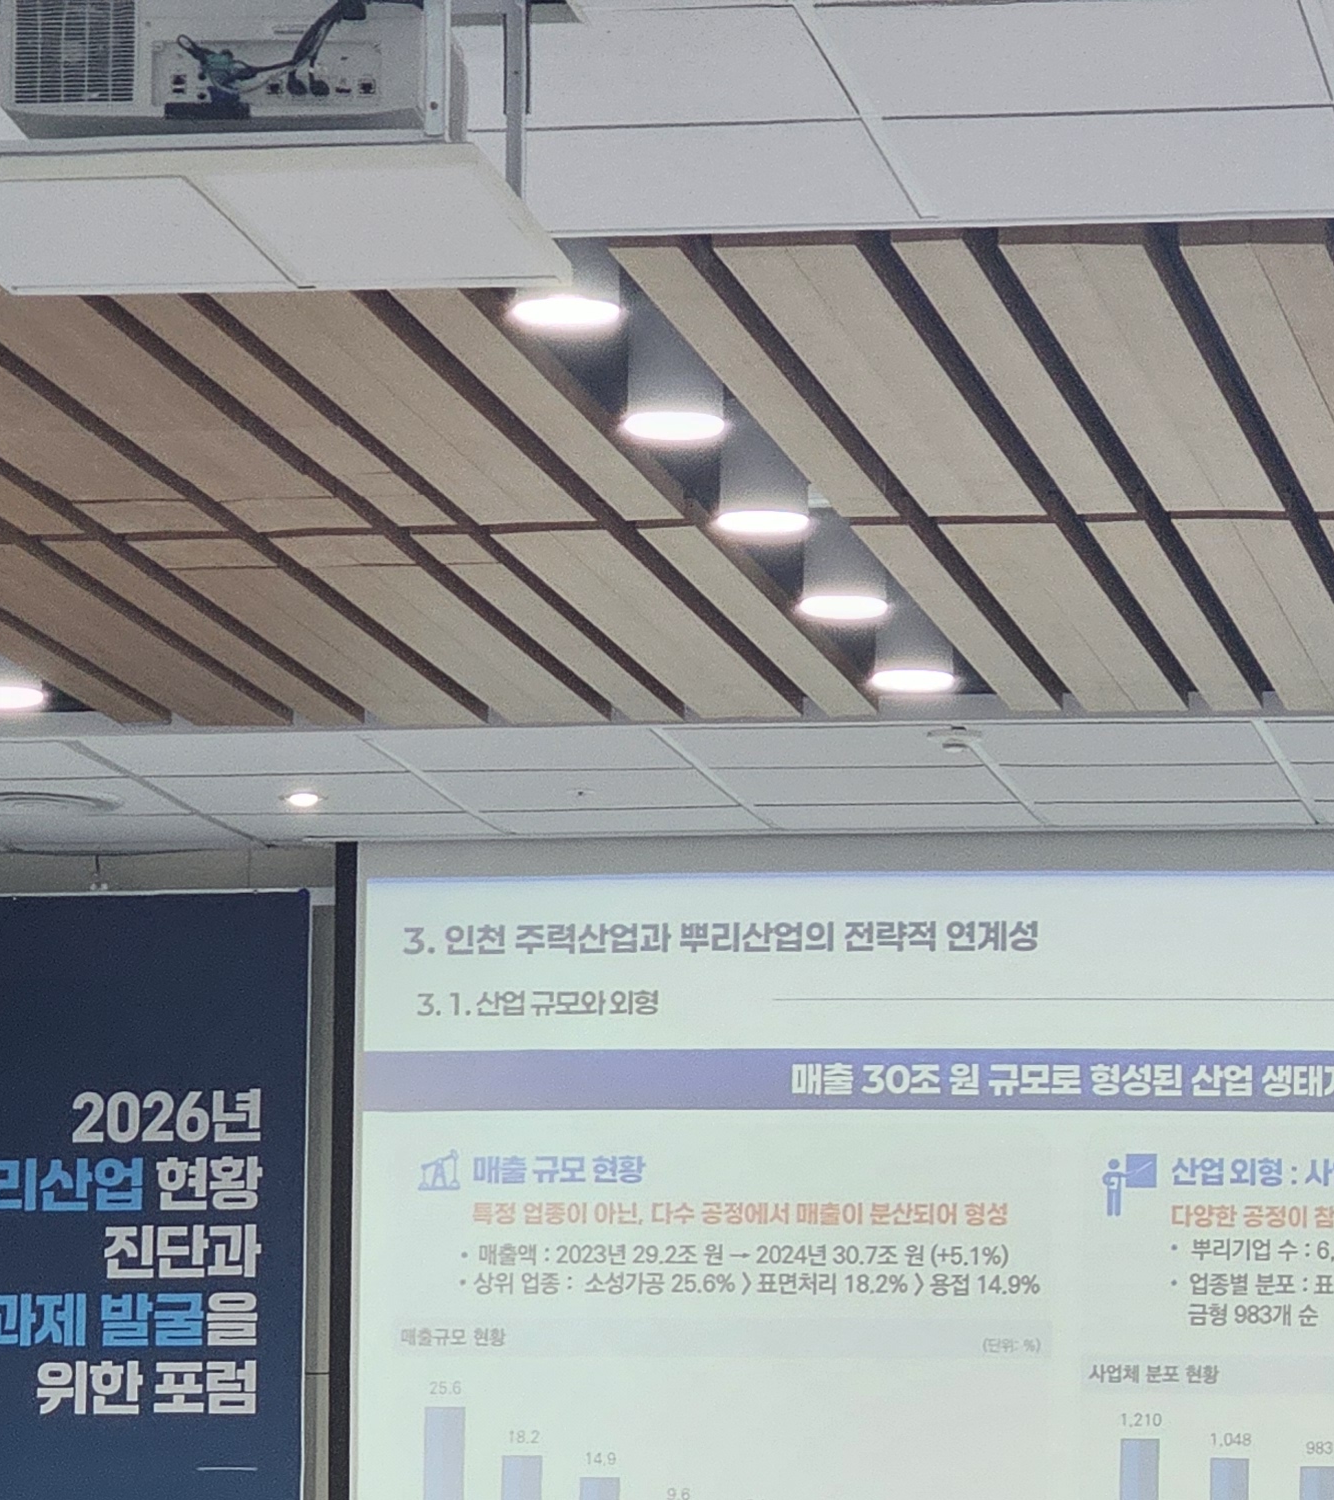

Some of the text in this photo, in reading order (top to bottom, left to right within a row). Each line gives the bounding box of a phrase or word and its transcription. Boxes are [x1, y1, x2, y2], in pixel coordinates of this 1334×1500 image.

[403, 921, 1038, 955] 3. 인천 주력산업과 뿌리산업의 전략적 연계성
[476, 991, 525, 1016] 산업
[531, 990, 606, 1016] 규모와
[609, 990, 658, 1015] 외형
[792, 1063, 853, 1095] 매출
[862, 1064, 940, 1094] 30조
[949, 1064, 979, 1095] 원
[988, 1064, 1081, 1096] 규모로
[1090, 1064, 1182, 1096] 형성된
[1192, 1065, 1252, 1096] 산업
[72, 1088, 261, 1143] 2026년
[473, 1155, 646, 1184] 매출 규모 현황
[1172, 1158, 1224, 1186] 산업
[1230, 1158, 1282, 1187] 외형
[156, 1156, 263, 1210] 현황
[472, 1202, 1007, 1226] 특정 업종이 아닌, 다수 공정에서 매출이 분산되어 형성
[1172, 1205, 1237, 1228] 다양한
[1243, 1205, 1307, 1228] 공정이
[104, 1224, 261, 1279] 진단과
[479, 1243, 536, 1266] 매출액
[556, 1244, 626, 1266] 2023년
[633, 1245, 698, 1264] 29.2조
[704, 1244, 723, 1266] 원
[756, 1244, 826, 1266] 2024년
[833, 1245, 898, 1265] 30.7조
[905, 1244, 924, 1267] 원
[931, 1244, 1009, 1268] (+5.1%)
[1191, 1238, 1270, 1261] 뿌리기업
[1278, 1239, 1298, 1261] 수
[474, 1272, 513, 1295] 상위
[521, 1272, 560, 1295] 업종
[585, 1272, 665, 1295] 소성가공
[671, 1273, 735, 1293] 25.6%
[757, 1273, 836, 1295] 표면처리
[845, 1274, 908, 1294] 18.2%
[930, 1273, 969, 1296] 용접
[978, 1275, 1040, 1295] 14.9%
[1190, 1273, 1248, 1296] 업종별
[1255, 1274, 1295, 1296] 분포
[101, 1292, 258, 1346] 발굴을
[1188, 1303, 1318, 1327] 금형 983개 순
[401, 1328, 506, 1347] 매출규모 현황
[1089, 1364, 1219, 1384] 사업체 분포 현황
[37, 1360, 256, 1414] 위한 포럼
[430, 1380, 461, 1395] 25.6
[1121, 1412, 1162, 1427] 1,210
[509, 1430, 540, 1444] 18.2
[1211, 1433, 1251, 1447] 1,048
[1306, 1441, 1333, 1455] 983
[586, 1452, 616, 1465] 14.9
[667, 1487, 691, 1500] 9.6
